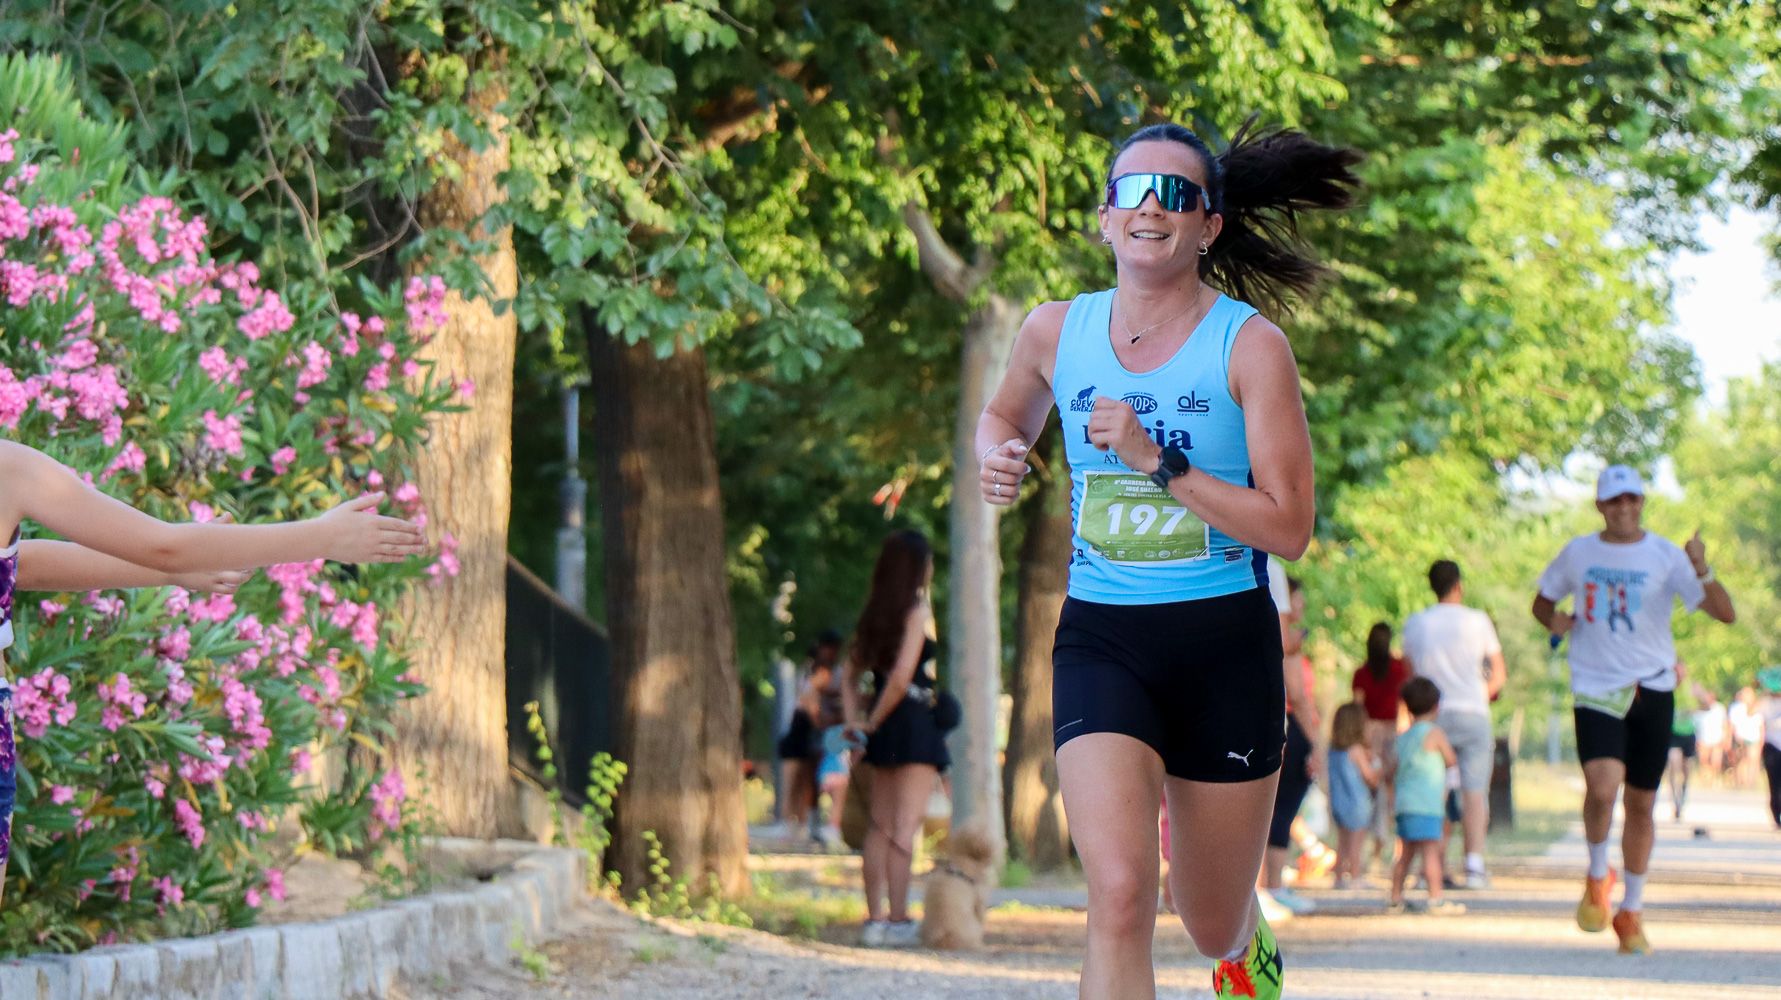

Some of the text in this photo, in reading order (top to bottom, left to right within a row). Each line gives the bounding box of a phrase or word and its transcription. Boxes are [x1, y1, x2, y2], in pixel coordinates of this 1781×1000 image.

[1121, 396, 1156, 412] ROPS
[1177, 390, 1209, 412] als
[1107, 503, 1187, 535] 197
